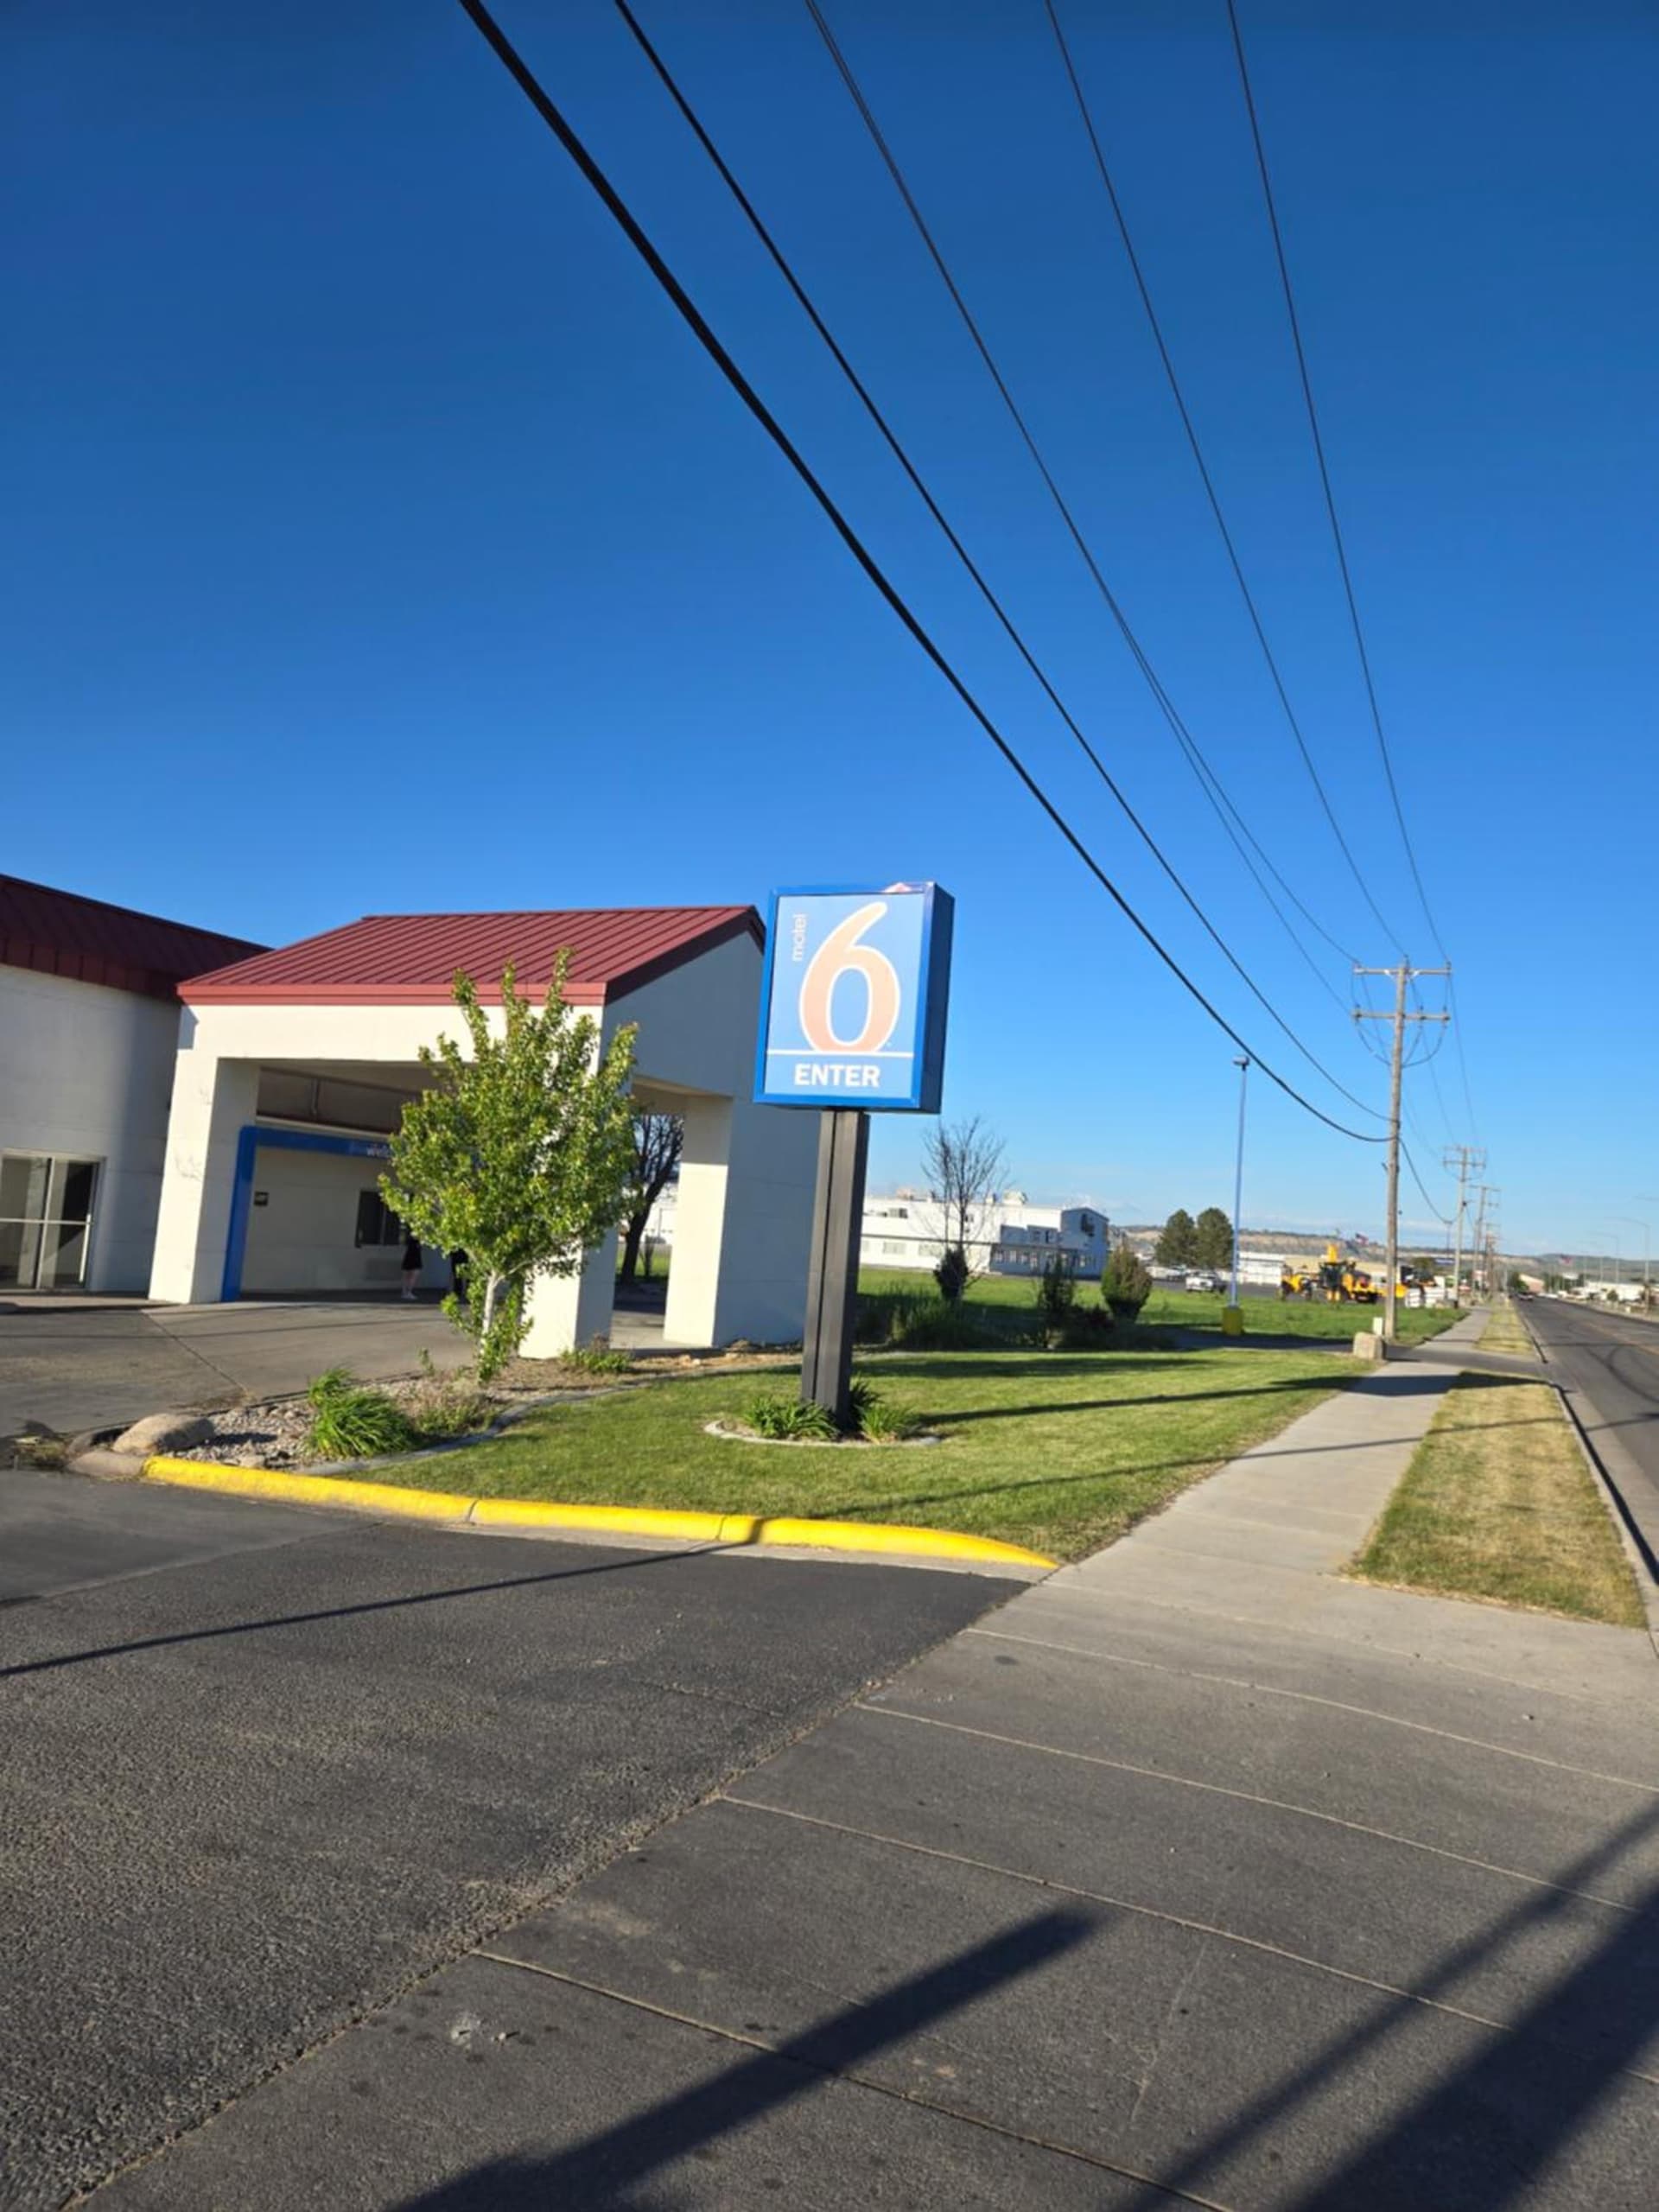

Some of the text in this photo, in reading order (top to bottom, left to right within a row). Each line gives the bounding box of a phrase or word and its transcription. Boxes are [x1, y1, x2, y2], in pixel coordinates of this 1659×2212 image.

[792, 913, 807, 961] motel
[799, 901, 900, 1052] 6
[794, 1064, 880, 1087] ENTER
